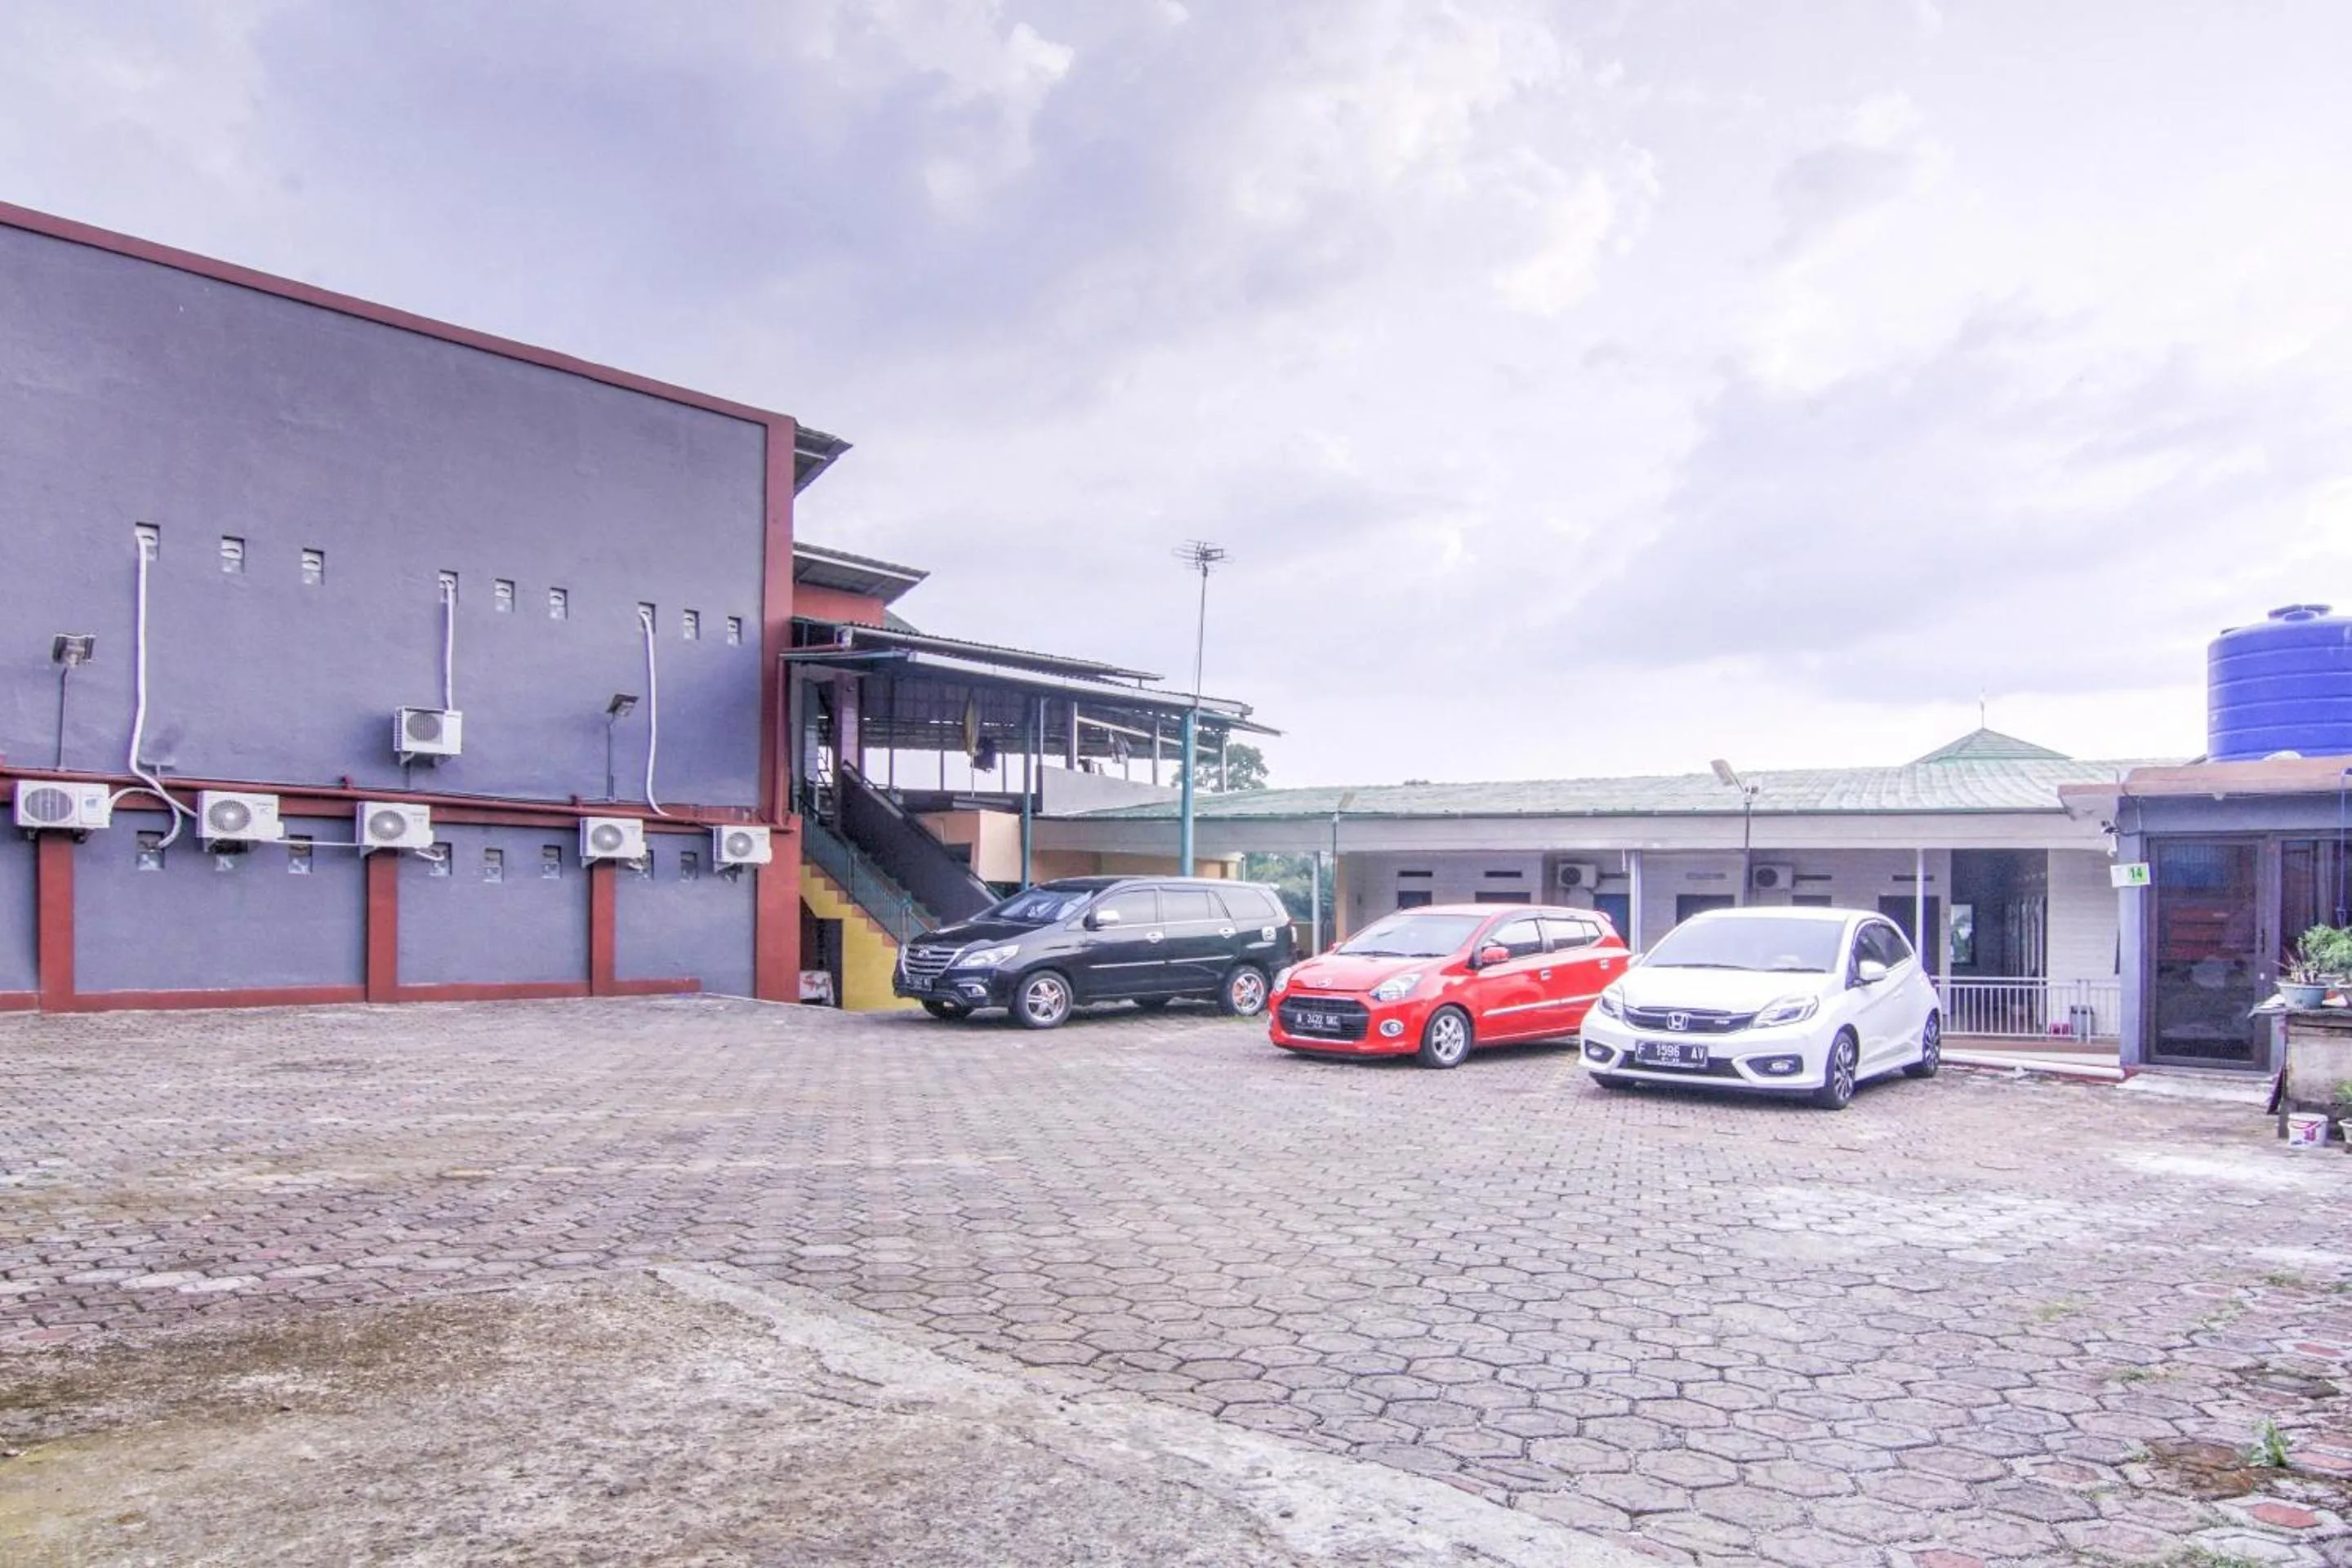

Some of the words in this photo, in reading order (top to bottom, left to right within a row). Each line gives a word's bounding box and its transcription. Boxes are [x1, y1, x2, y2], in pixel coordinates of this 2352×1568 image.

[2130, 866, 2143, 880] 14
[1637, 1042, 1646, 1054] F
[1656, 1045, 1681, 1058] 1596
[1691, 1045, 1704, 1059] AV
